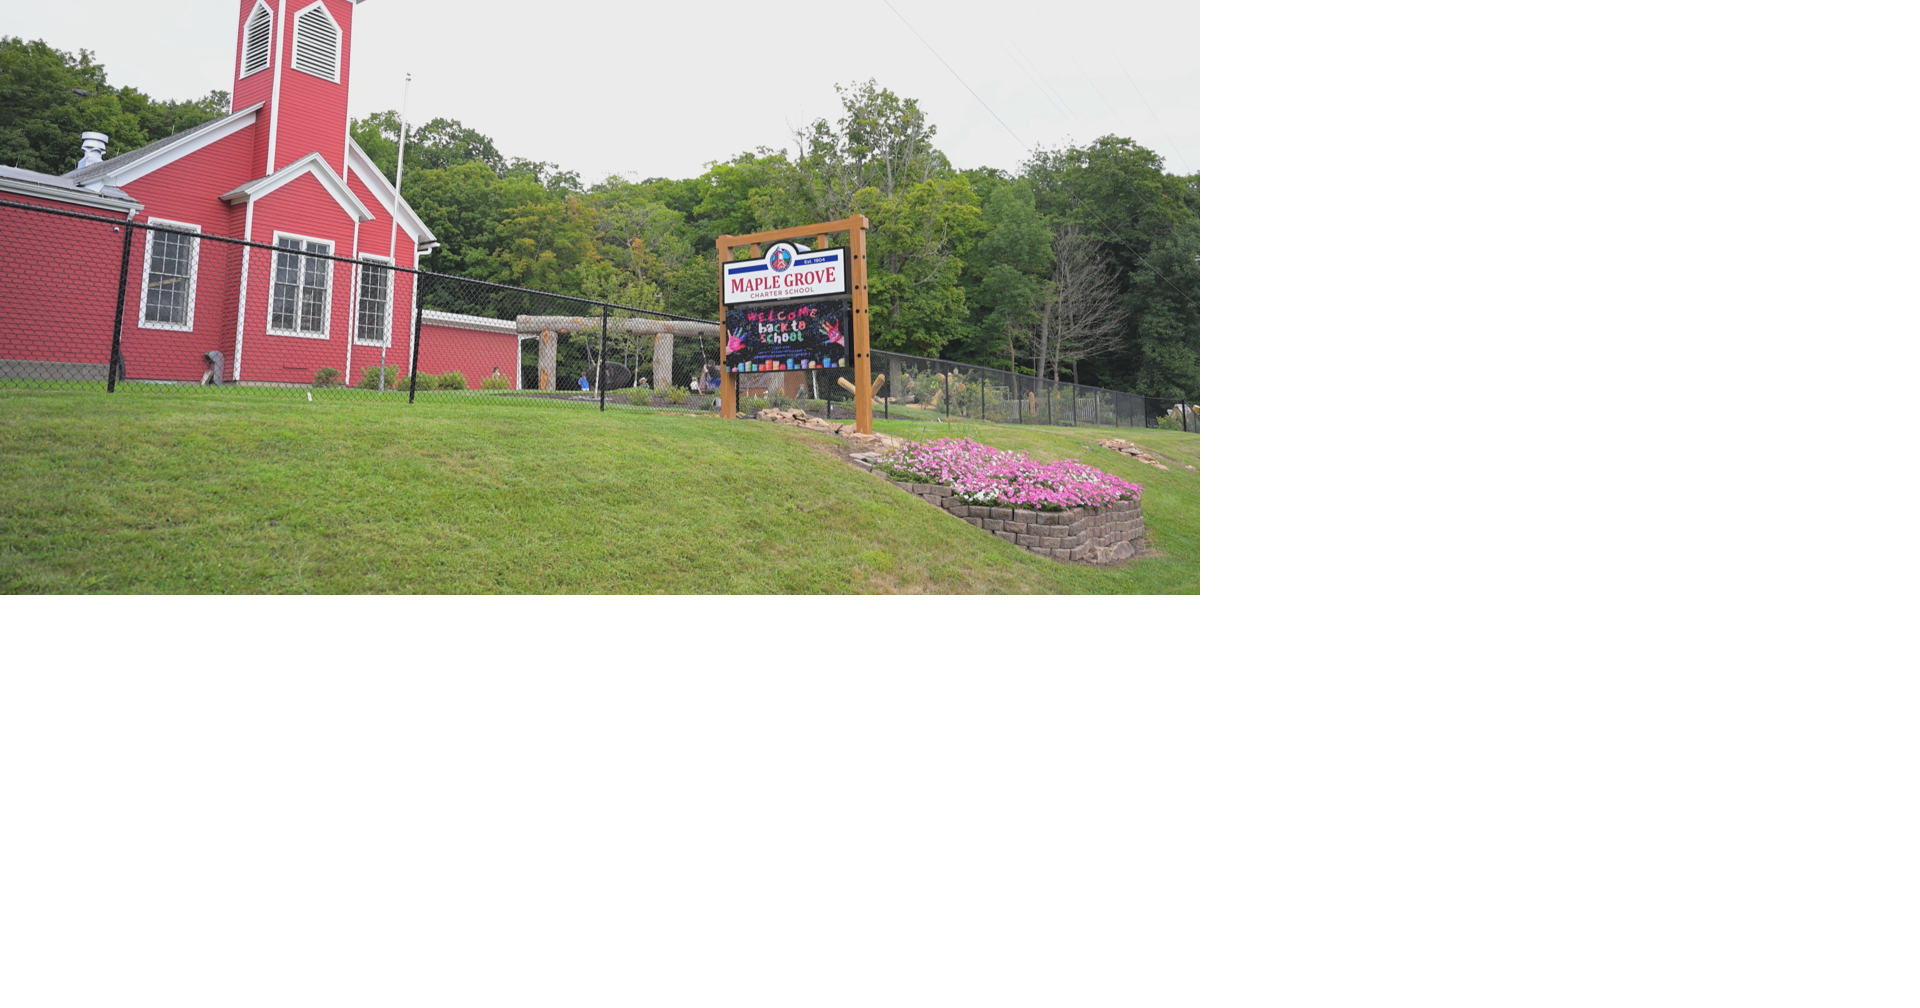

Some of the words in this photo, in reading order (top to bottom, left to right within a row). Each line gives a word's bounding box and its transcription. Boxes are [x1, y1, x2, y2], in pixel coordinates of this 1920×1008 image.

[731, 275, 780, 294] MAPLE
[784, 266, 836, 288] GROVE
[750, 290, 782, 299] CHARTER
[785, 287, 814, 295] SCHOOL
[748, 306, 817, 322] WELCOME
[758, 322, 788, 334] back
[792, 320, 806, 332] to
[760, 332, 804, 344] school
